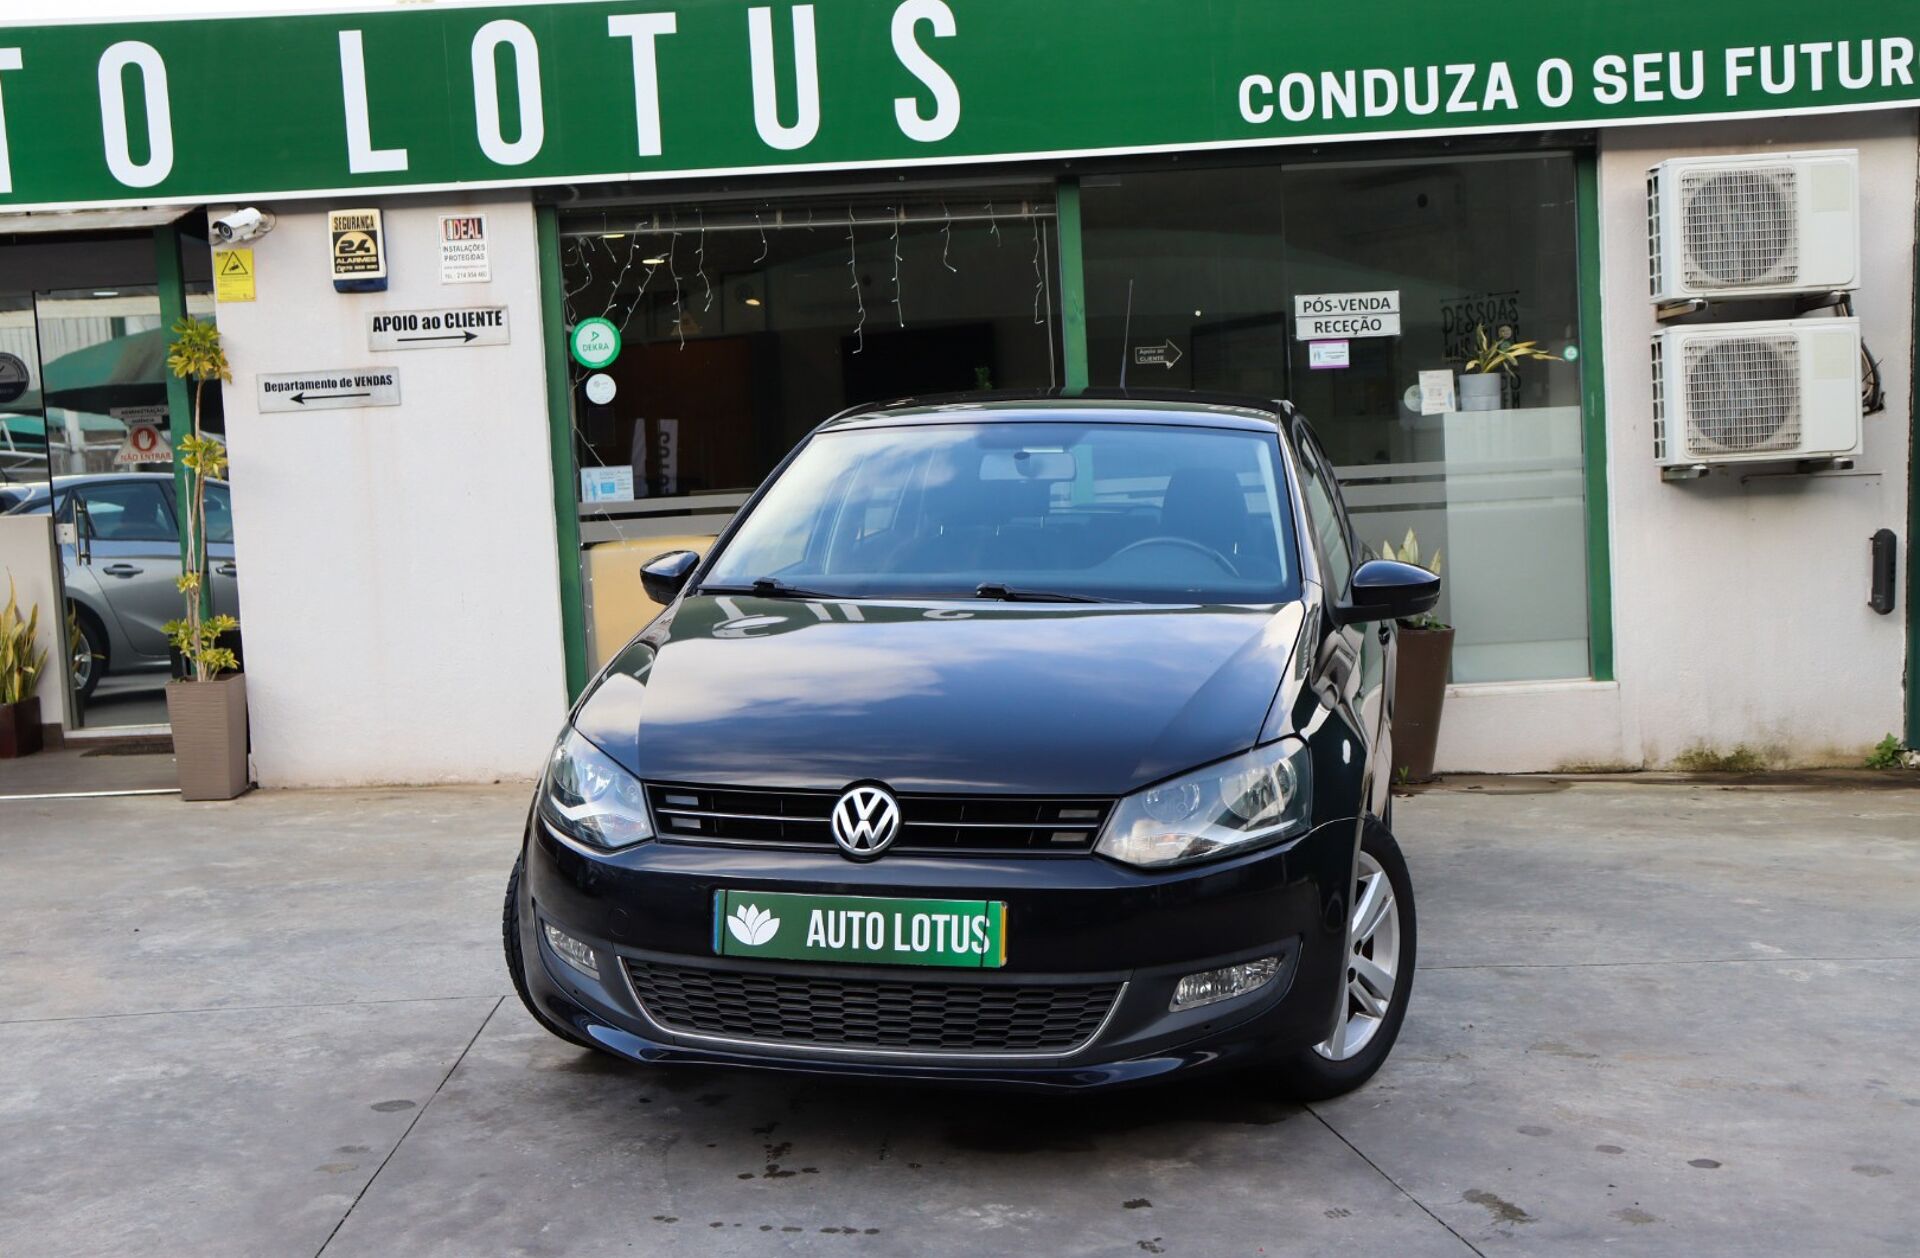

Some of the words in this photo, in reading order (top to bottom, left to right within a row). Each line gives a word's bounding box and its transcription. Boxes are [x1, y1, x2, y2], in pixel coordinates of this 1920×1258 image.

[338, 0, 960, 175] LOTUS
[1238, 61, 1519, 124] CONDUZA
[1536, 58, 1574, 107] O
[1592, 50, 1704, 104] SEU
[1725, 37, 1920, 98] FUTUR
[333, 215, 375, 231] SEGURANÇA
[445, 217, 483, 240] IDEAL
[339, 239, 371, 254] 24
[443, 243, 486, 253] INSTALAÇÕES
[336, 256, 377, 264] ALARMES
[444, 253, 485, 262] PROTEGIDAS
[1303, 297, 1391, 314] PÓS-VENDA
[373, 314, 418, 333] APOIO
[422, 316, 441, 330] ao
[444, 310, 503, 329] CLIENTE
[1314, 316, 1382, 335] RECEÇÃO
[582, 343, 610, 352] DEKRA
[264, 379, 338, 393] Departamento
[339, 377, 353, 388] de
[354, 374, 393, 387] VENDAS
[120, 452, 139, 462] NÃO
[140, 451, 171, 461] ENTRAR
[806, 908, 885, 950] AUTO
[894, 912, 990, 954] LOTUS
